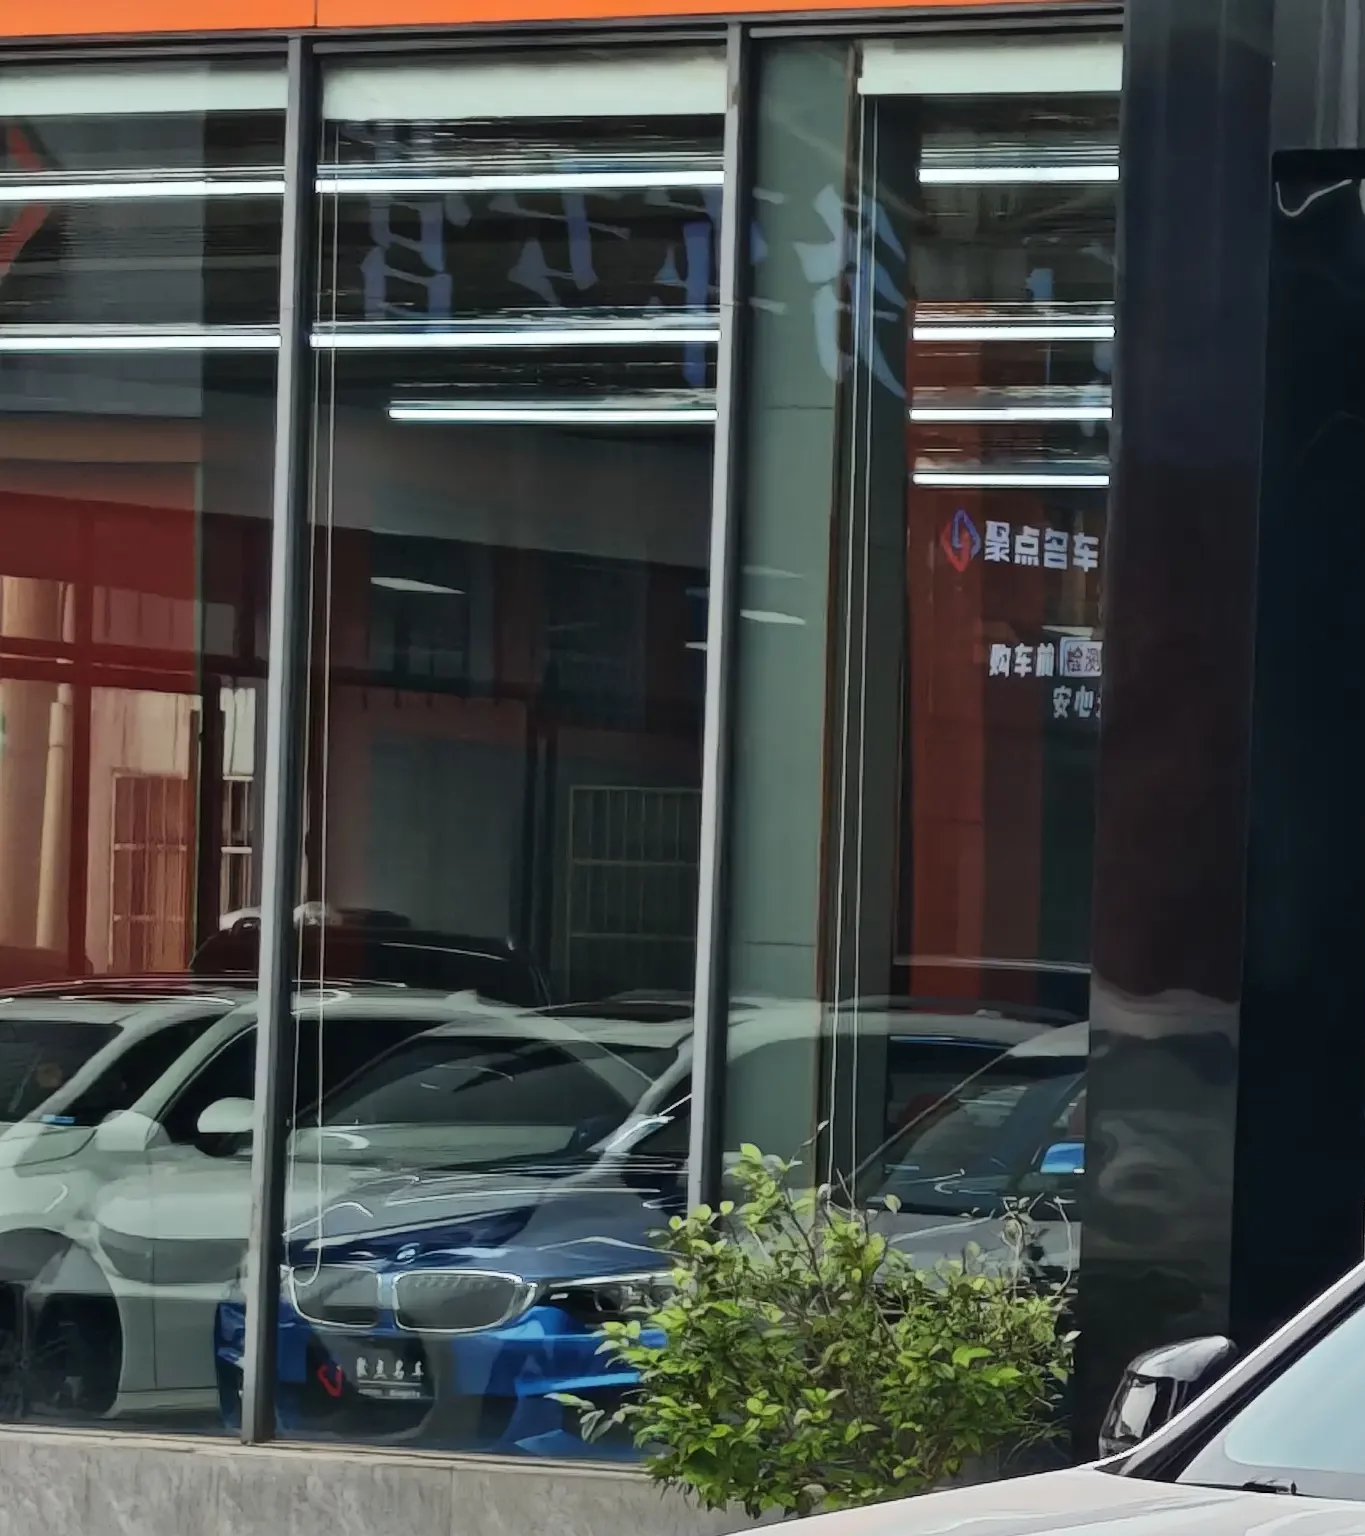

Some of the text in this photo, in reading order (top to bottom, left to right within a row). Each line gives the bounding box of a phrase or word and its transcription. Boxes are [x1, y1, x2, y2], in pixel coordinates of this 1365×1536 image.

[984, 520, 1100, 572] 聚点名车
[1052, 685, 1101, 719] 安心
